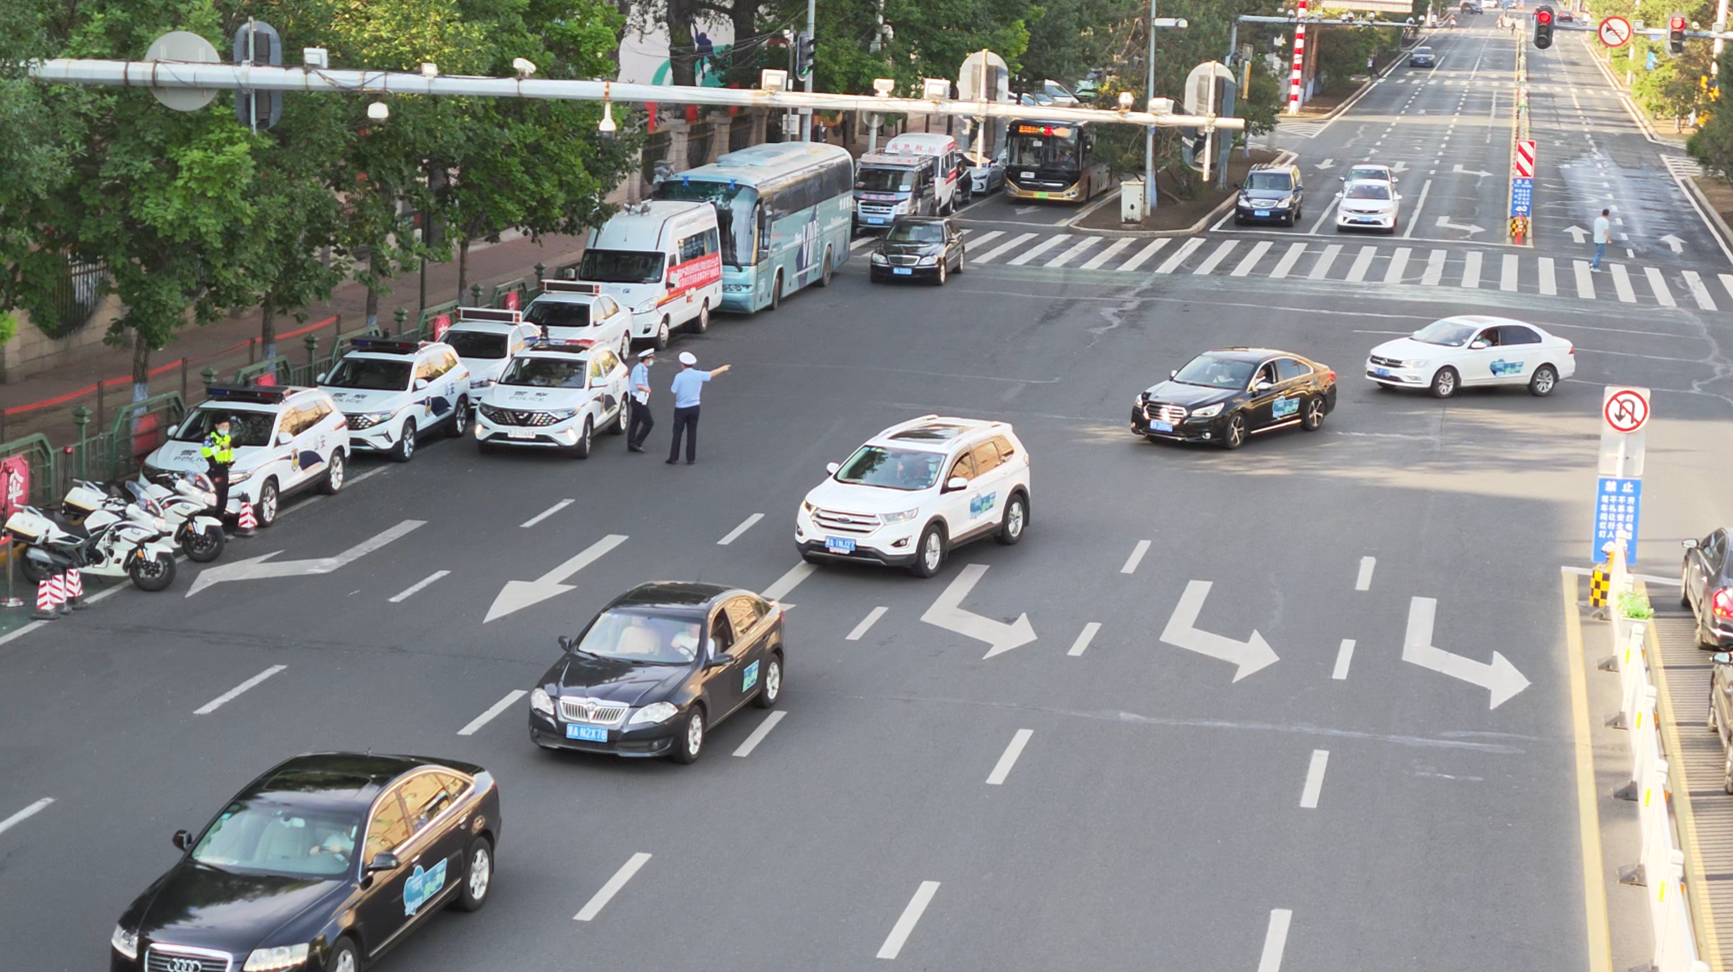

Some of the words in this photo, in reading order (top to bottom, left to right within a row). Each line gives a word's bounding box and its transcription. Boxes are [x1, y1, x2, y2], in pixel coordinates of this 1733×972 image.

[1605, 481, 1633, 492] 禁止
[1607, 495, 1617, 538] 不礼让行人
